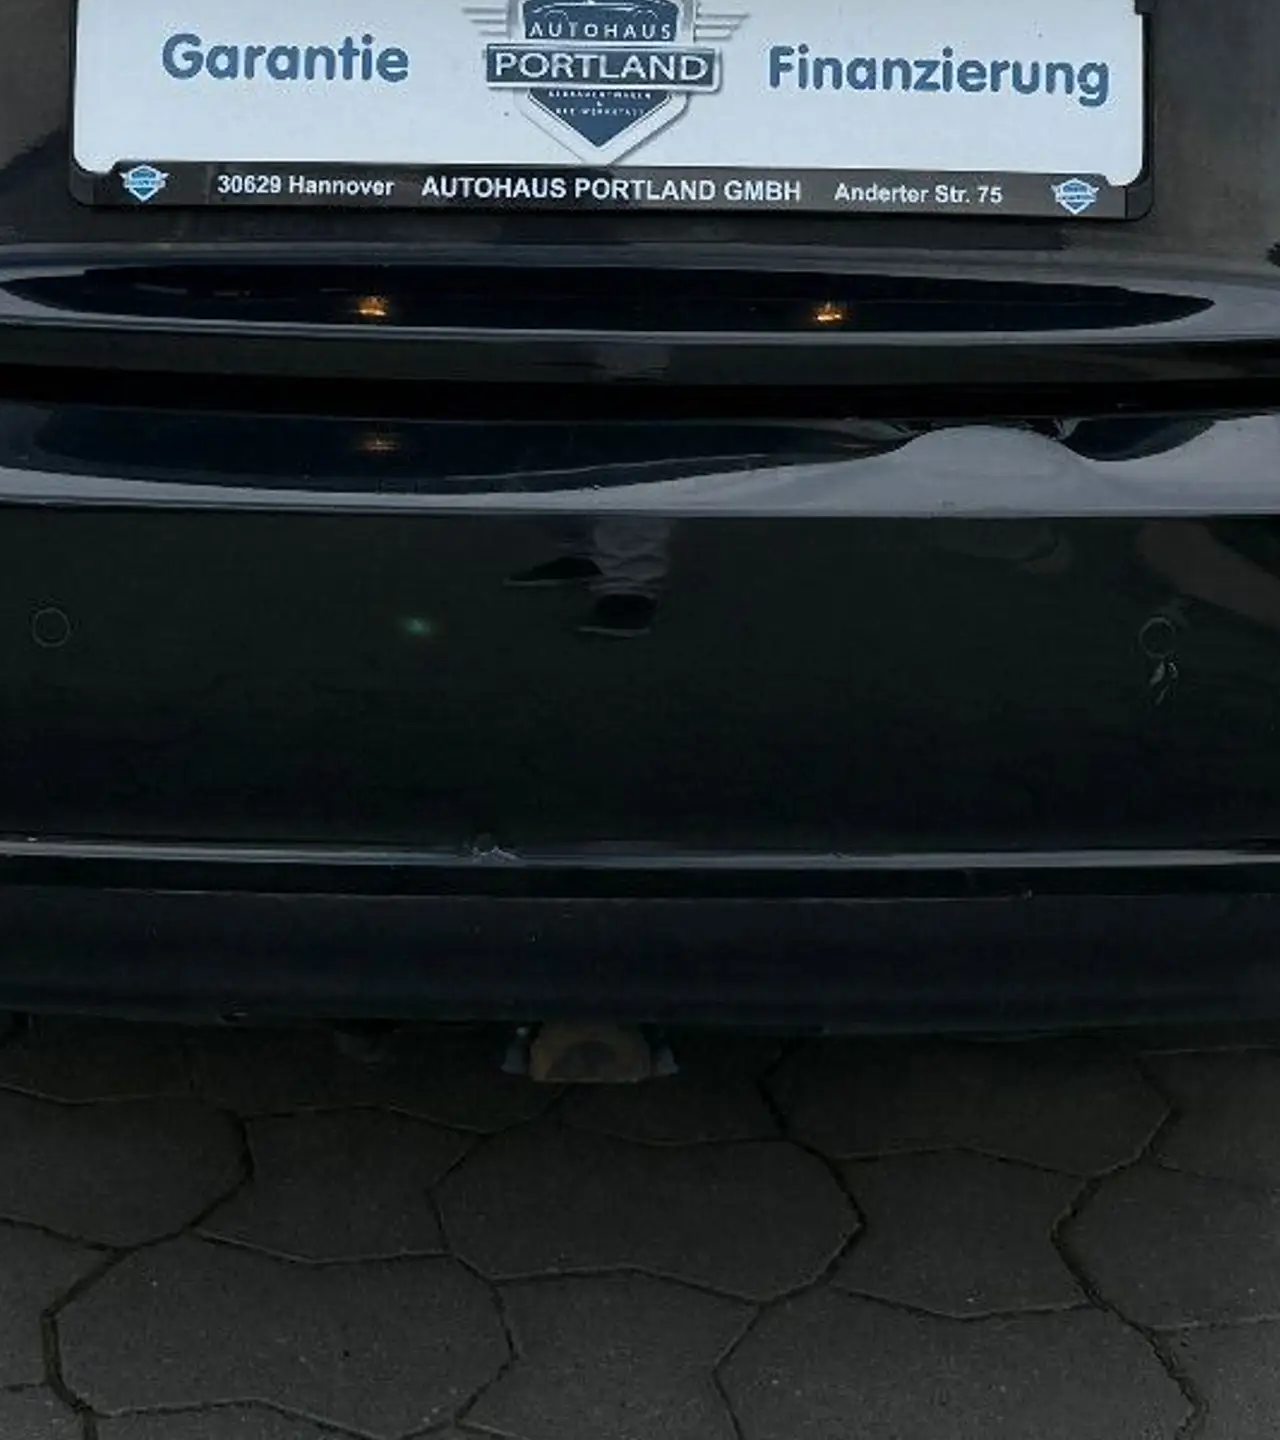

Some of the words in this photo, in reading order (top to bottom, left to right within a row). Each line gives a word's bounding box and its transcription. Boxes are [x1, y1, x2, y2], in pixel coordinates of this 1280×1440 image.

[528, 21, 671, 40] AUTOHAUS
[162, 32, 409, 82] Garantie
[494, 52, 710, 81] PORTLAND
[769, 43, 1109, 108] Finanzierung
[217, 174, 282, 194] 30629
[288, 176, 395, 196] Hannover
[421, 175, 567, 199] AUTOHAUS
[575, 178, 716, 201] PORTLAND
[724, 180, 802, 202] GMBH
[834, 182, 928, 203] Anderter
[934, 184, 971, 203] Str.
[977, 185, 1004, 203] 75
